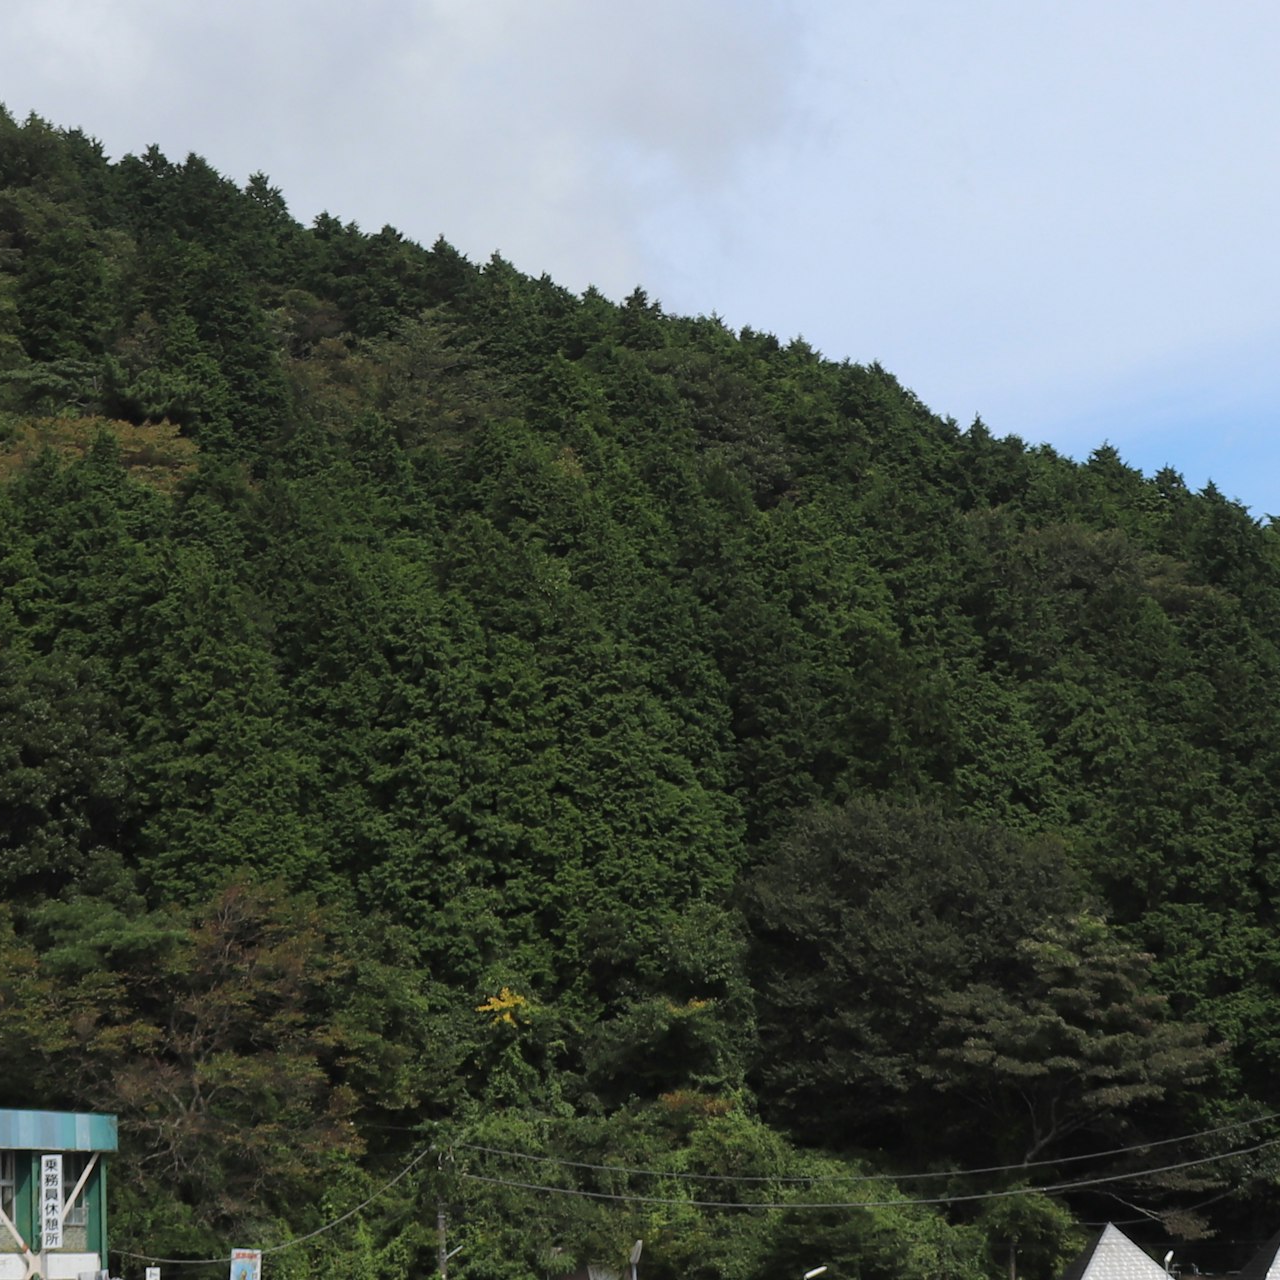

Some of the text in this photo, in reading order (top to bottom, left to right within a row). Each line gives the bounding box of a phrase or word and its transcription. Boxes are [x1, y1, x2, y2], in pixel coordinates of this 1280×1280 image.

[44, 1158, 58, 1246] 乗務員休憩所
